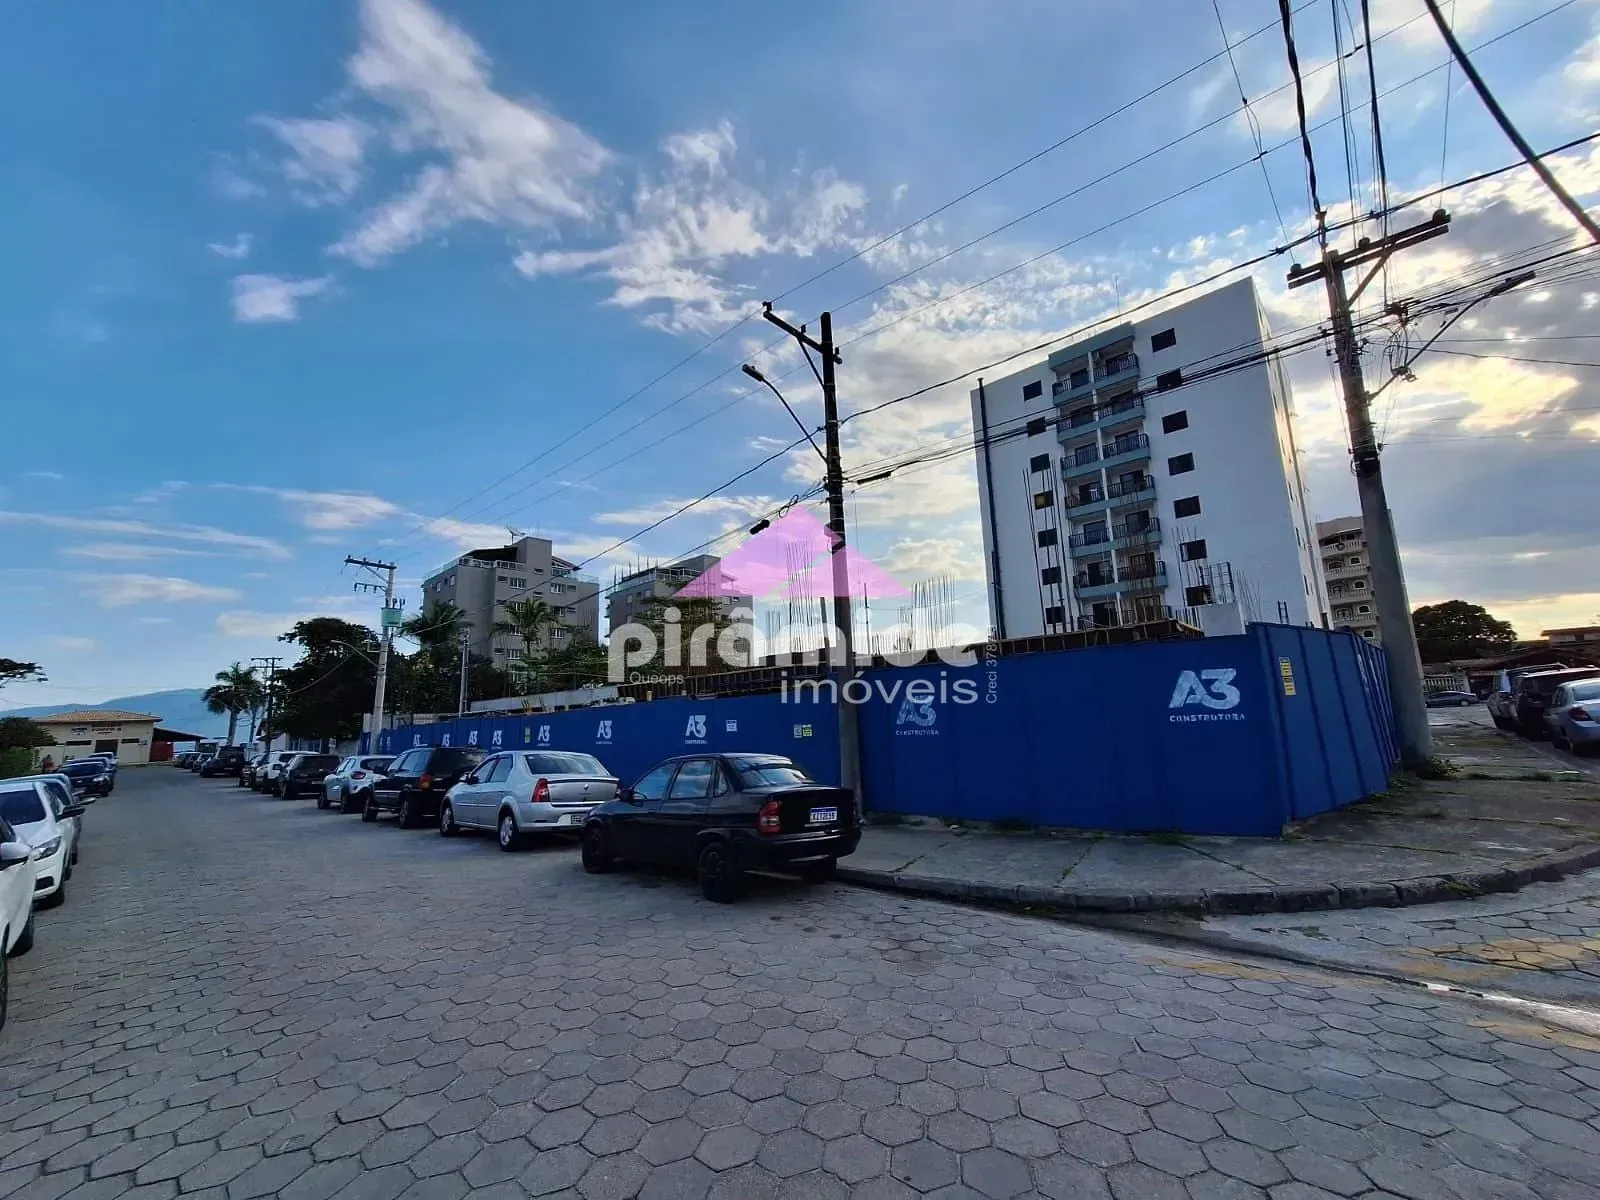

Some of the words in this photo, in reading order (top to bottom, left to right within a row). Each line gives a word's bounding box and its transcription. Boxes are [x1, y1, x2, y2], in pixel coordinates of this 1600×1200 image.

[1168, 668, 1240, 709] A3
[685, 715, 707, 738] A3
[1169, 713, 1245, 722] CONSTRUTORA
[538, 725, 551, 742] A3
[596, 720, 612, 739] A3
